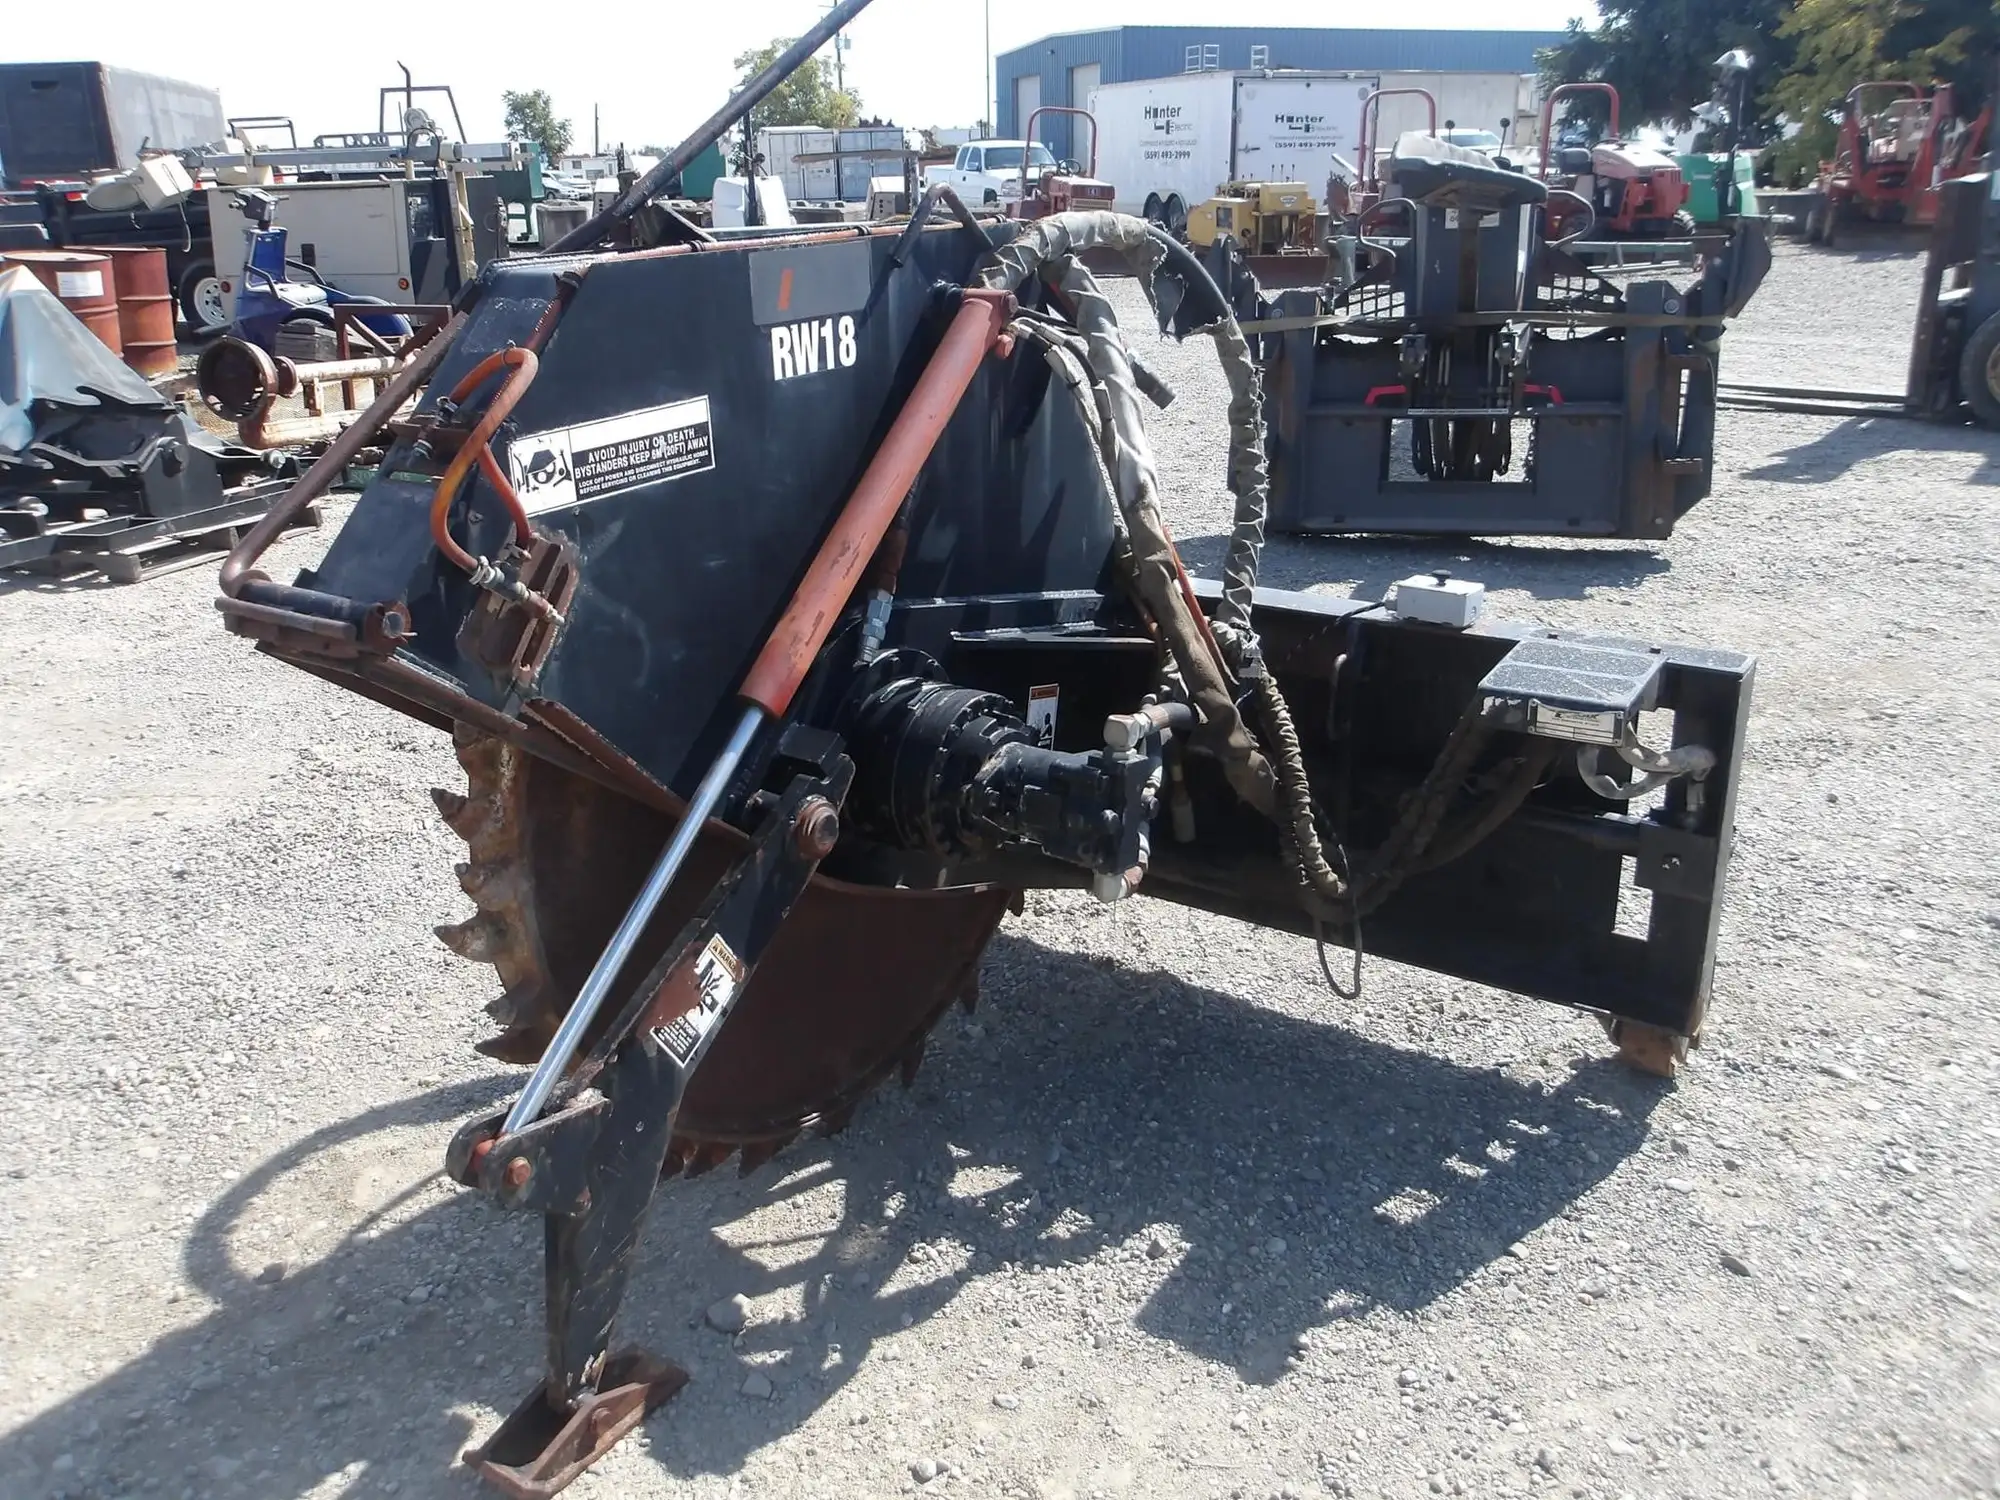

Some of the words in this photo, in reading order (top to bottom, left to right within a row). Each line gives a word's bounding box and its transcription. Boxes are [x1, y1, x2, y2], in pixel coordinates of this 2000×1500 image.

[770, 315, 857, 381] RW18
[574, 456, 628, 479] BYSTANDERS
[630, 450, 650, 466] KEEP
[663, 442, 686, 459] (20FT)
[688, 435, 708, 452] AWAY
[588, 446, 616, 464] AVOID
[618, 438, 650, 456] INJURY
[652, 435, 666, 448] OR
[668, 428, 694, 444] DEATH
[578, 479, 593, 488] LOCK
[594, 476, 604, 484] OFF
[604, 472, 624, 482] POWER
[624, 468, 635, 476] AND
[579, 484, 600, 495] BEFORE
